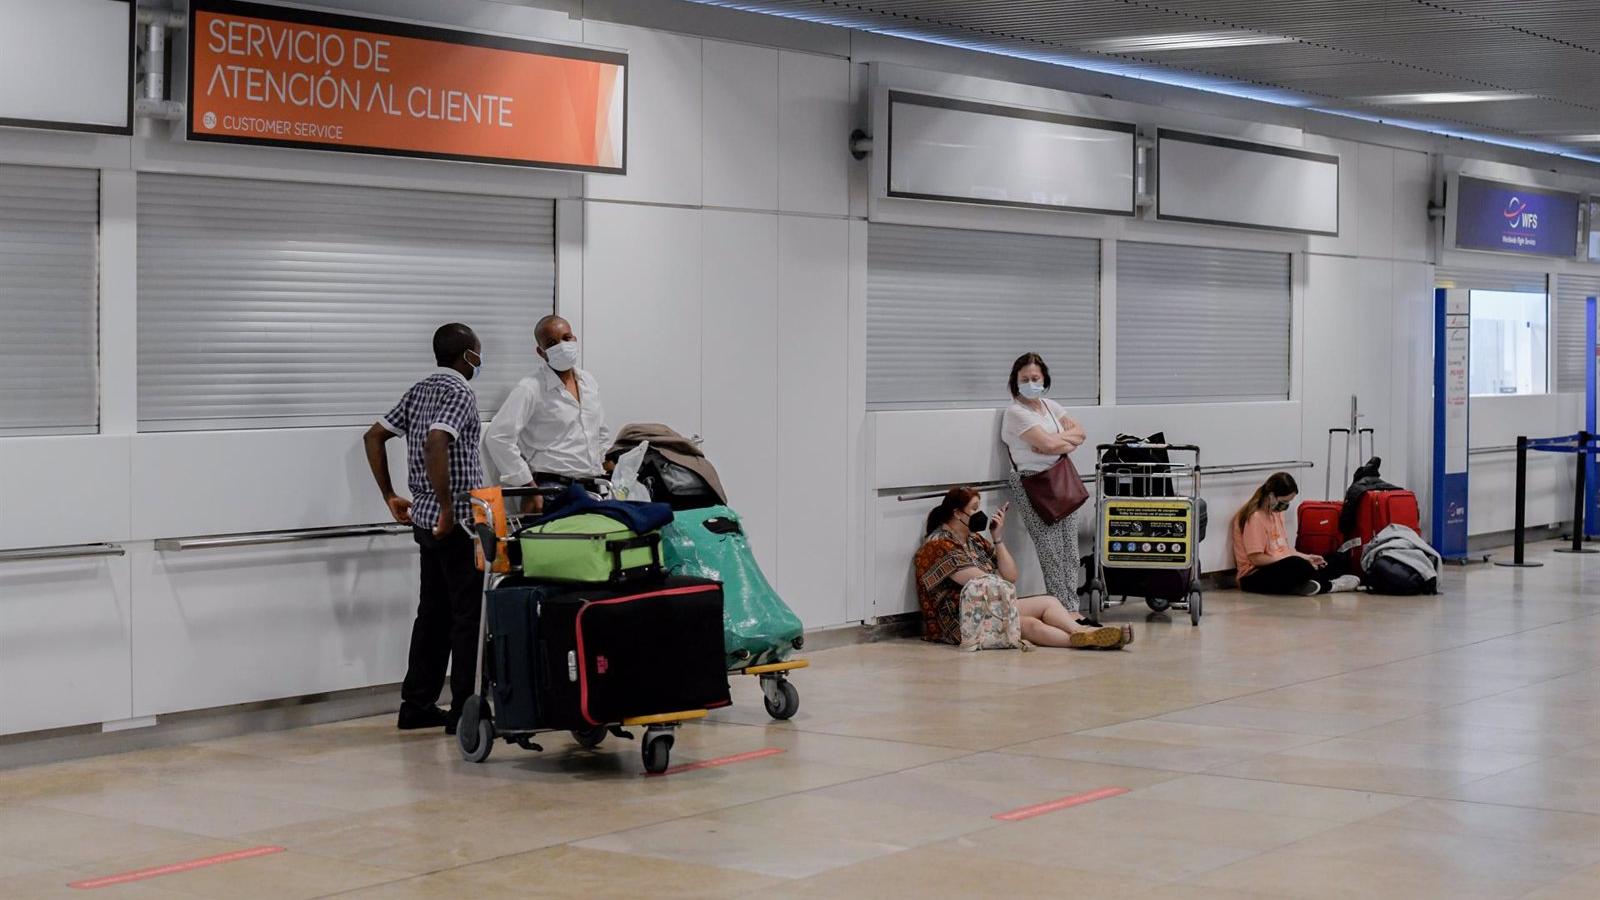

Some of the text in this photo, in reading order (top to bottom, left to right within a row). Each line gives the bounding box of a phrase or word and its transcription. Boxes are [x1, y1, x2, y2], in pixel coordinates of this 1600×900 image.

[207, 18, 391, 73] SERVICIO DE
[207, 64, 515, 128] ATENCIÓN AL CLIENTE
[223, 115, 291, 136] CUSTOMER
[294, 122, 344, 140] SERVICE
[1521, 213, 1538, 229] WFS
